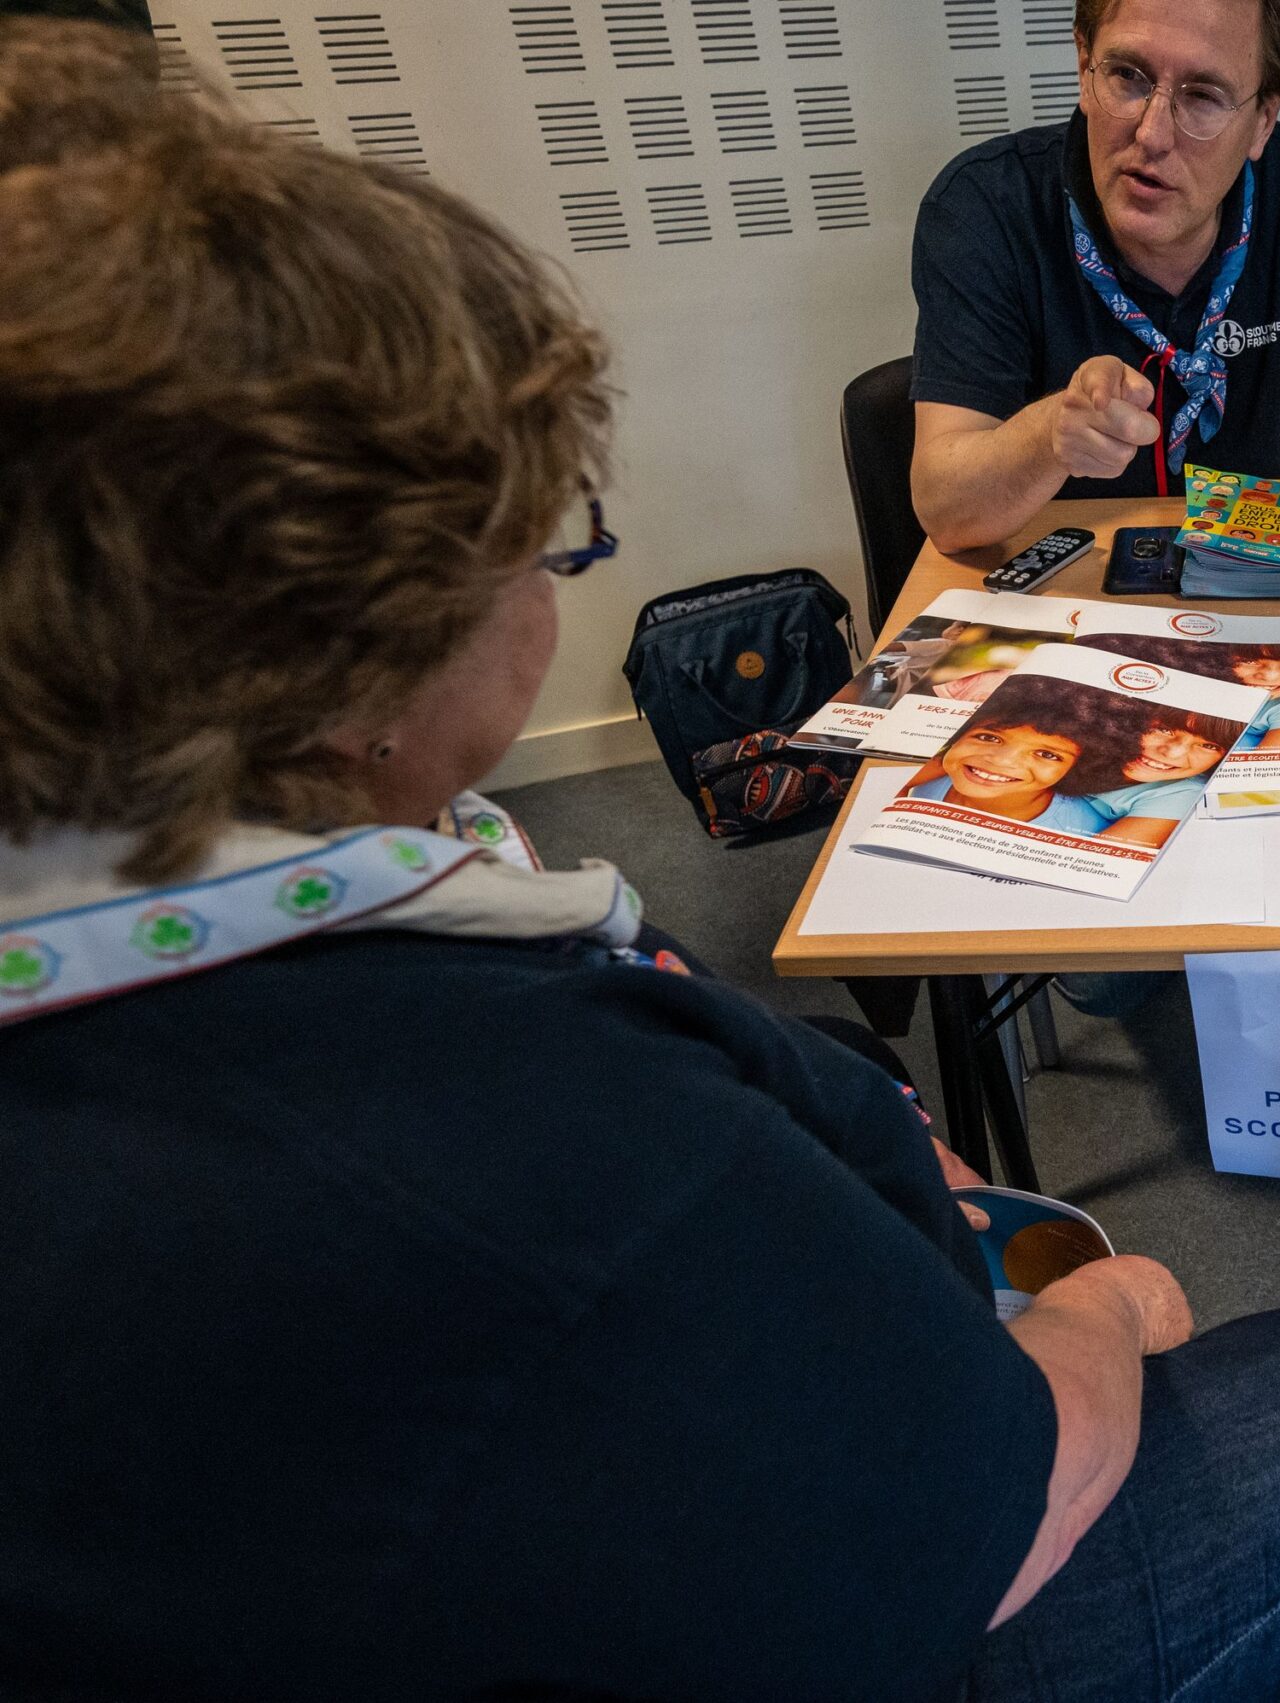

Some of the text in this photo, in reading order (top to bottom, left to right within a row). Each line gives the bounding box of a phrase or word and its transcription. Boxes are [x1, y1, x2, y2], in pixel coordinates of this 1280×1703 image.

[1242, 503, 1276, 513] TOUS
[831, 707, 856, 716] UNE
[917, 704, 974, 717] VERS LES
[841, 717, 874, 729] POUR
[911, 804, 951, 817] ENFANTS
[951, 811, 962, 819] ET
[964, 813, 980, 824] LES
[981, 818, 1014, 833] JEUNES
[1015, 828, 1055, 844] VEULENT
[1055, 834, 1078, 848] ÊTRE
[910, 819, 963, 836] propositions
[965, 831, 977, 839] de
[978, 834, 996, 846] près
[998, 838, 1010, 847] de
[1011, 843, 1029, 851] 700
[1029, 847, 1062, 860] enfants
[1064, 854, 1074, 862] et
[1074, 857, 1104, 869] jeunes
[938, 833, 955, 841] aux
[956, 837, 994, 852] élections
[995, 847, 1056, 866] présidentielle
[1069, 863, 1121, 879] législatives.
